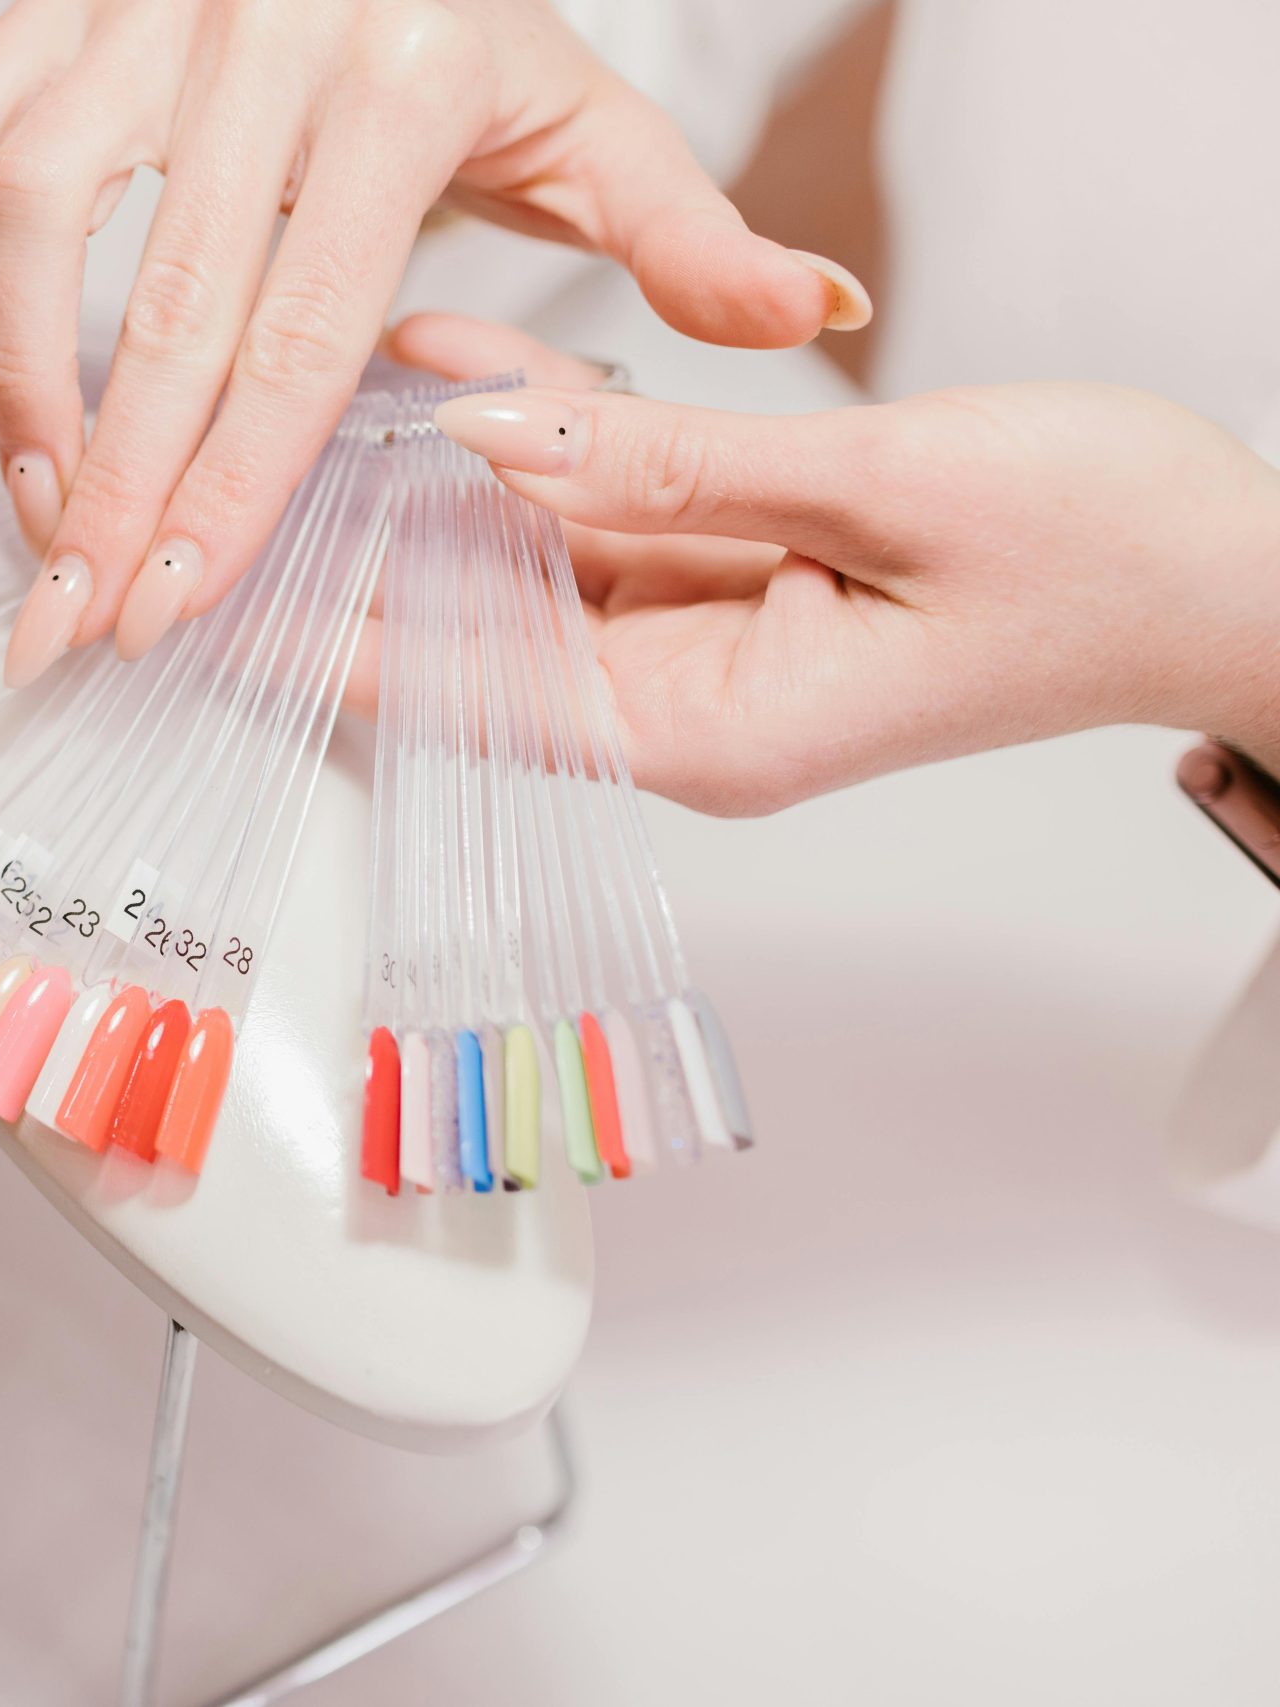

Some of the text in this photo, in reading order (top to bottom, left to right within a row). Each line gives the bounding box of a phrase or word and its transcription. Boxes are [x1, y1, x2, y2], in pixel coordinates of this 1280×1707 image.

[62, 898, 101, 938] 23
[175, 928, 207, 972] 32
[222, 936, 254, 975] 28
